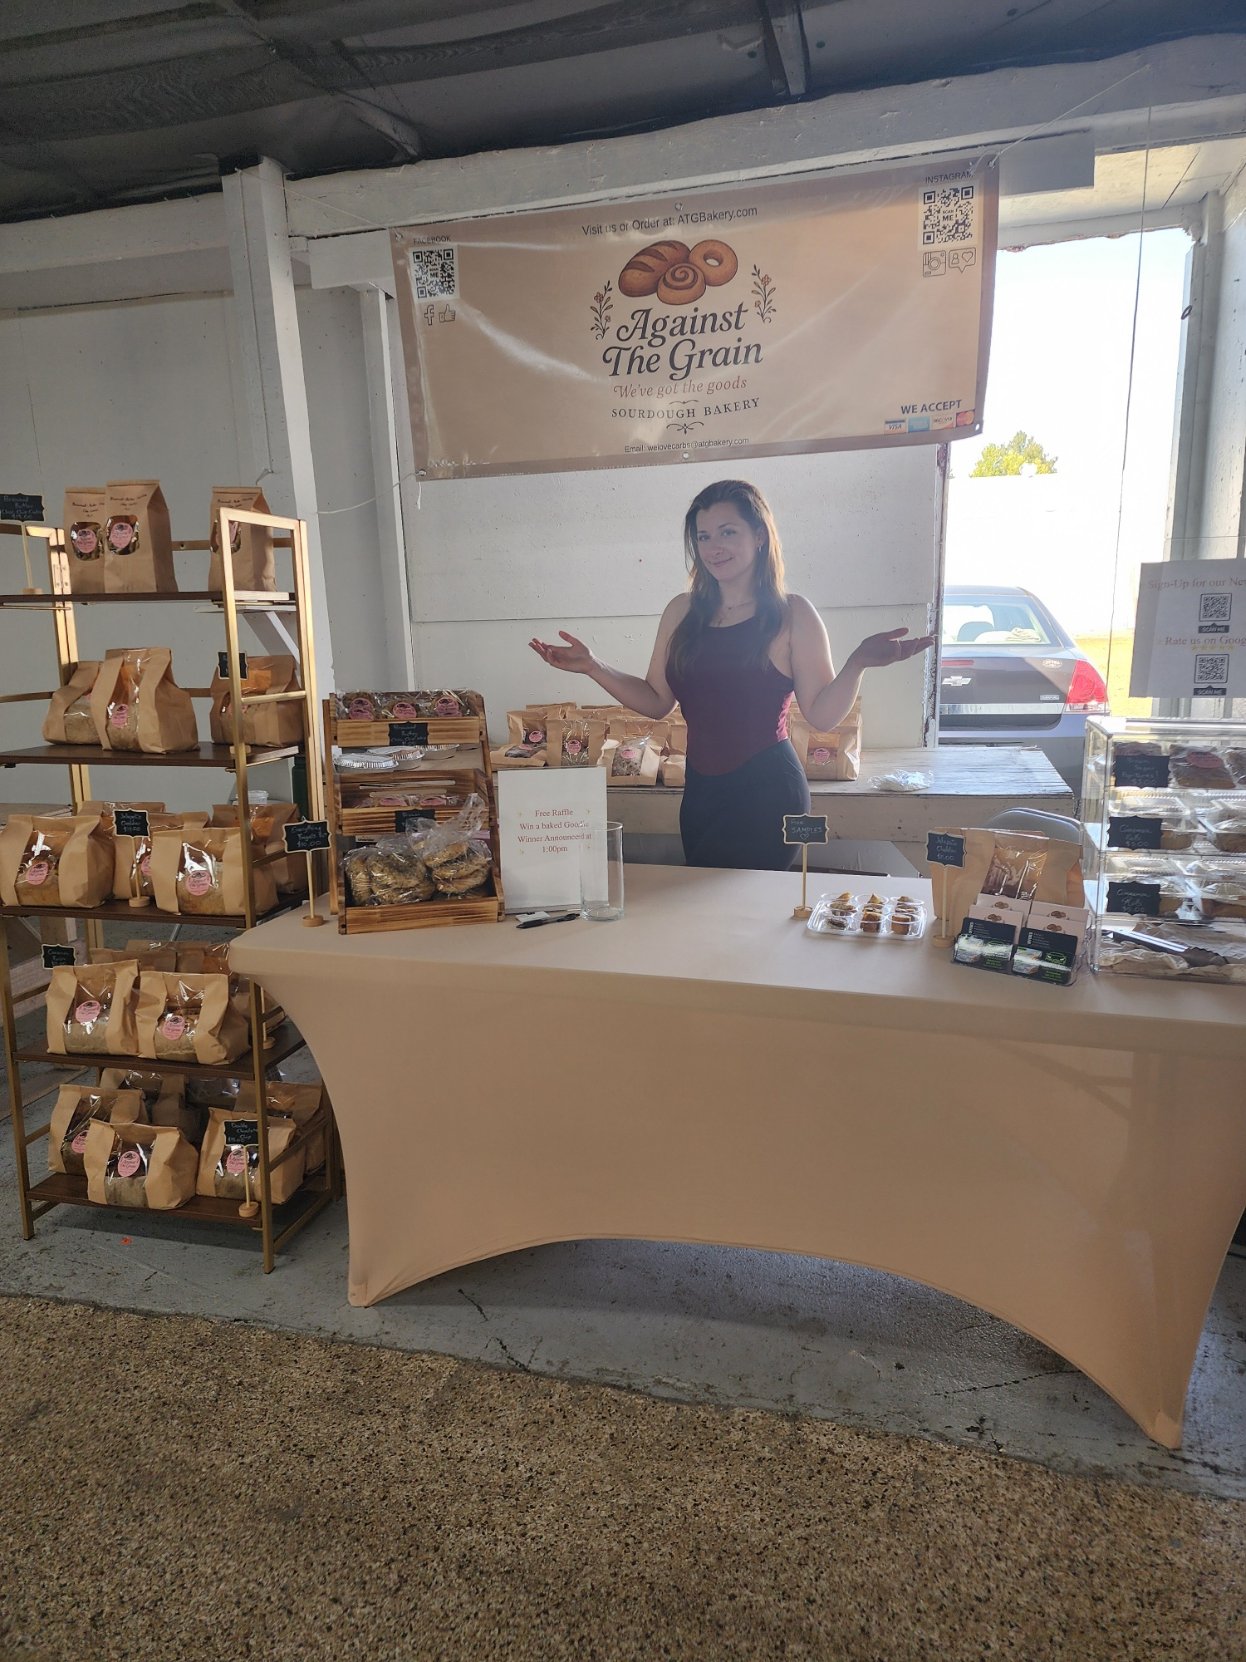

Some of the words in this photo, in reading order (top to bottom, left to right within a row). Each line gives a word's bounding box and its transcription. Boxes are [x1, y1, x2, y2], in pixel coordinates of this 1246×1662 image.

[582, 223, 603, 236] Visit
[605, 222, 617, 233] us
[619, 221, 629, 232] or
[632, 217, 660, 231] Order
[663, 216, 675, 227] at:
[677, 206, 758, 225] ATGBakery.com
[616, 302, 749, 348] Against
[602, 345, 661, 377] The
[669, 337, 764, 382] Grain
[613, 384, 654, 399] We've
[657, 381, 679, 399] got
[682, 379, 704, 393] the
[707, 375, 748, 395] goods
[611, 408, 697, 419] SOURDOUGH
[704, 397, 760, 417] BAKERY
[901, 404, 917, 415] WE
[920, 399, 962, 413] ACCEPT
[1148, 578, 1190, 591] Sign-Up
[1192, 577, 1206, 588] for
[1209, 579, 1225, 587] our
[1165, 637, 1187, 646] Rate
[535, 809, 551, 817] Free
[552, 808, 574, 817] Raffle
[519, 822, 534, 831] Win
[541, 821, 562, 830] baked
[517, 835, 543, 843] Winner
[542, 845, 568, 854] 1:00pm
